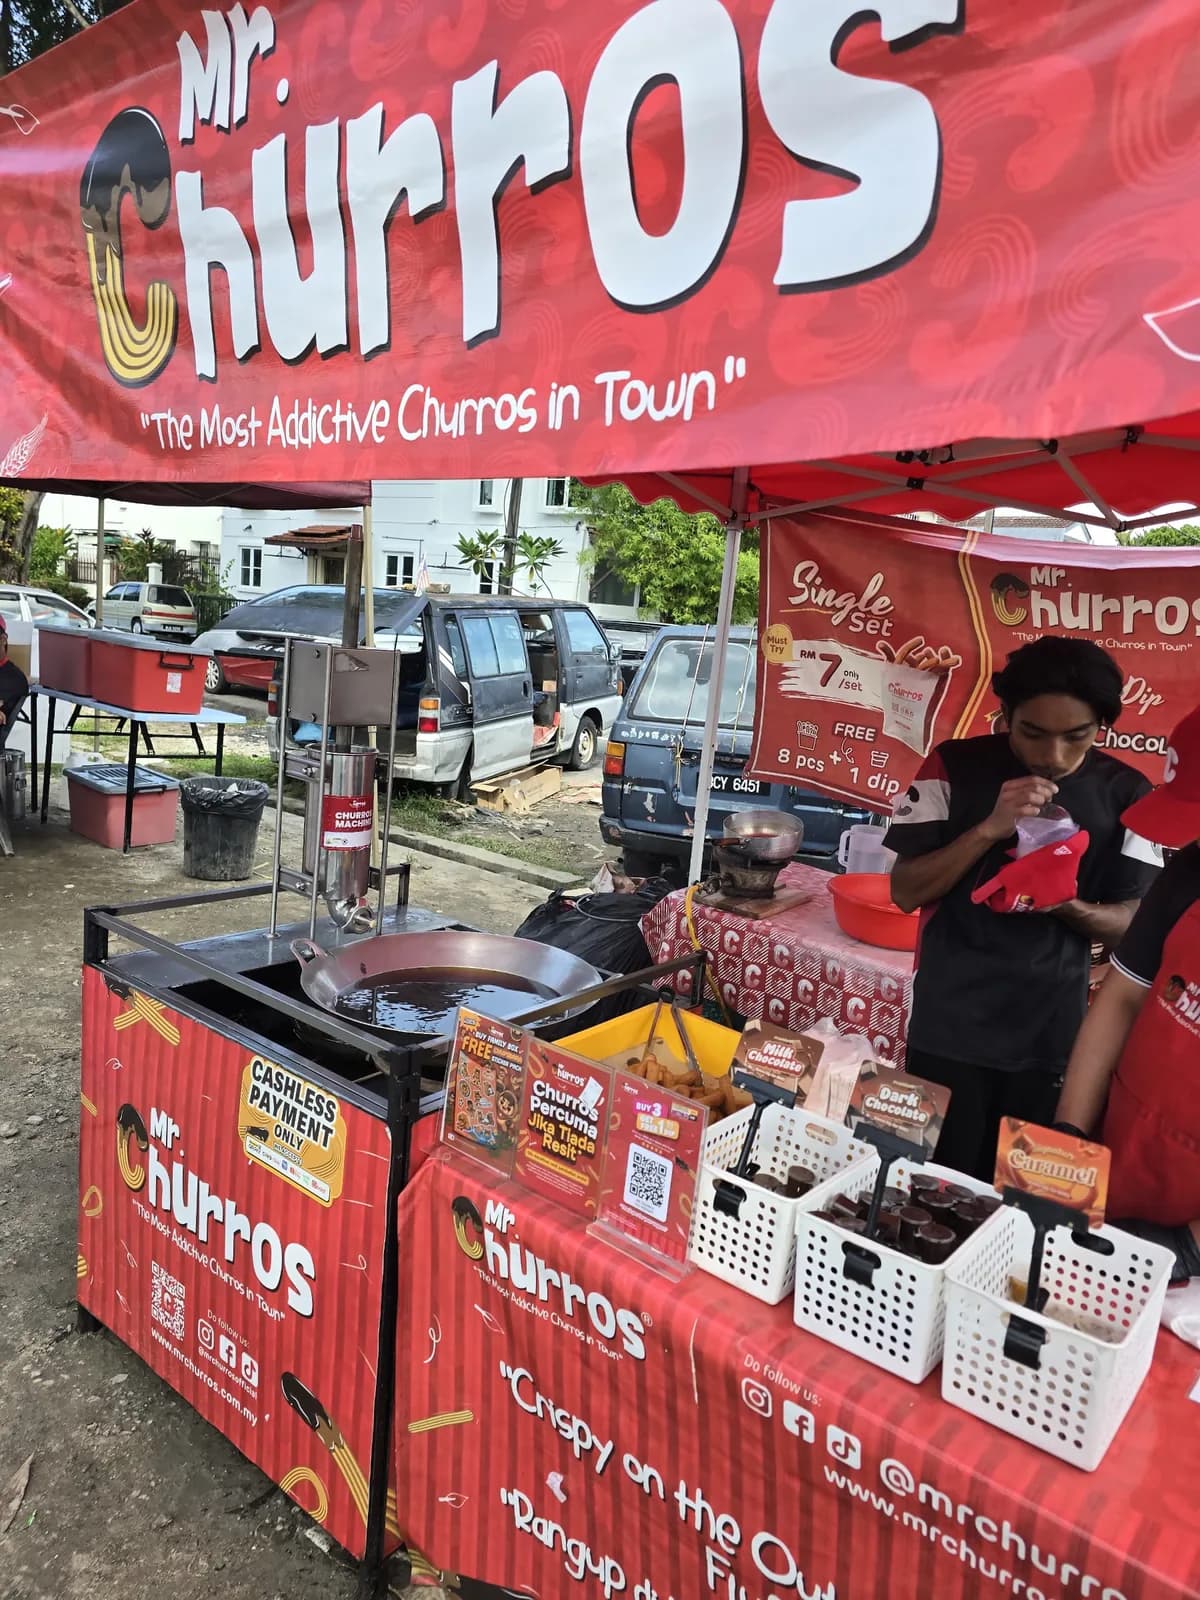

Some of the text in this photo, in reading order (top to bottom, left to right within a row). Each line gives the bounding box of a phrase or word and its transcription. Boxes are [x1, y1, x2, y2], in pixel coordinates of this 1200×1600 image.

[177, 2, 289, 145] Mr.
[80, 0, 965, 388] Churros
[141, 355, 746, 451] "The Most Addictive Churros in Town"
[788, 560, 894, 626] Single
[1030, 566, 1072, 587] Mr.
[989, 573, 1200, 636] Churro
[767, 635, 788, 646] Must
[849, 612, 893, 637] Set
[1106, 638, 1146, 650] Churros
[1147, 642, 1157, 650] in
[770, 645, 785, 654] Try
[800, 650, 843, 687] RM 7
[838, 679, 863, 691] /set
[843, 670, 859, 680] only
[1119, 675, 1165, 715] Dip
[834, 722, 876, 742] FREE
[733, 777, 760, 793] 6451
[777, 748, 790, 763] 8
[796, 755, 825, 772] pcs
[850, 767, 859, 784] 1
[867, 773, 899, 797] dip
[462, 1036, 493, 1060] FREE
[748, 1050, 802, 1072] Chocolate
[763, 1043, 794, 1059] Milk
[252, 1060, 336, 1123] CASHLESS
[533, 1080, 598, 1122] Churros
[636, 1102, 652, 1113] BUY
[652, 1103, 662, 1117] 3
[865, 1096, 927, 1122] Chocolate
[880, 1086, 919, 1107] Dark
[249, 1085, 333, 1147] PAYMENT
[530, 1095, 598, 1140] Percuma
[274, 1124, 303, 1151] ONLY
[1008, 1149, 1097, 1187] Caramel
[117, 1103, 315, 1318] Churros
[151, 1211, 171, 1237] Most
[172, 1229, 209, 1267] Addictive
[209, 1257, 245, 1296] Churros
[246, 1289, 254, 1301] in
[207, 1309, 217, 1322] Do
[218, 1318, 238, 1340] follow
[511, 1293, 549, 1321] Addictive
[550, 1312, 585, 1341] Churros
[586, 1335, 594, 1345] in
[151, 1327, 258, 1427] www.mrchurros.com.my
[198, 1346, 258, 1400] @mrchurrosofficial
[744, 1353, 822, 1407] Do follow us:
[500, 1360, 614, 1474] "Crispy
[623, 1453, 664, 1500] on
[674, 1479, 741, 1555] the
[500, 1487, 626, 1600] "Rangup
